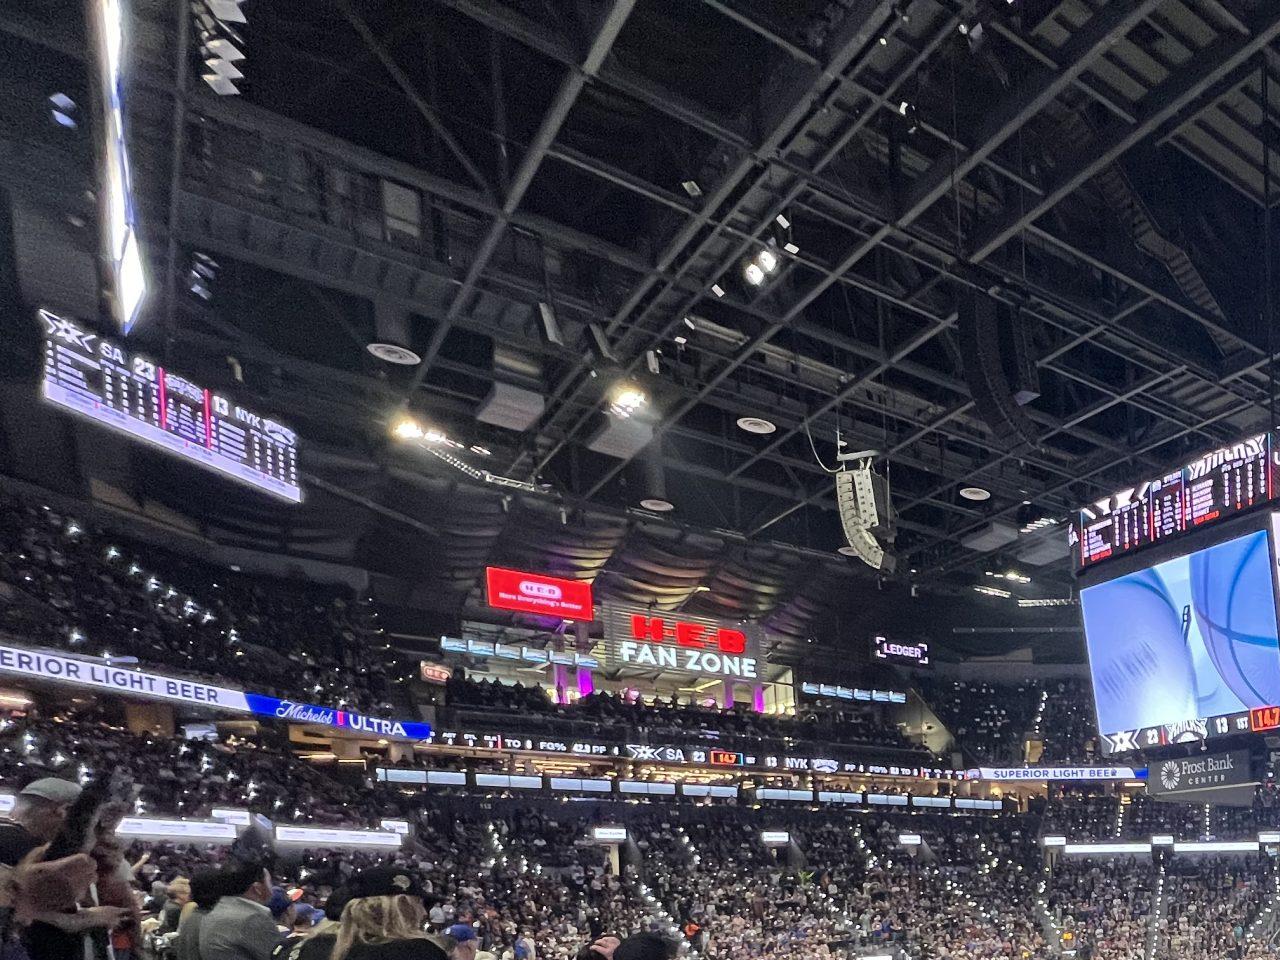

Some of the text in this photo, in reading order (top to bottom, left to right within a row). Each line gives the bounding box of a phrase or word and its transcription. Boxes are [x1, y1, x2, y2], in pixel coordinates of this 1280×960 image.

[620, 641, 758, 678] FAN ZONE
[883, 643, 922, 658] LEDGER
[91, 666, 157, 692] LIGHT
[166, 681, 219, 703] BEER
[276, 700, 333, 724] Michelob
[350, 713, 408, 737] ULTRA
[1146, 728, 1159, 745] 23
[1215, 717, 1229, 734] 13
[666, 749, 685, 761] SA
[785, 757, 808, 769] NYK
[1182, 754, 1234, 775] Frost Bank
[994, 769, 1049, 779] SUPERIOR
[1053, 769, 1085, 778] LIGHT
[1188, 774, 1226, 785] CENTER
